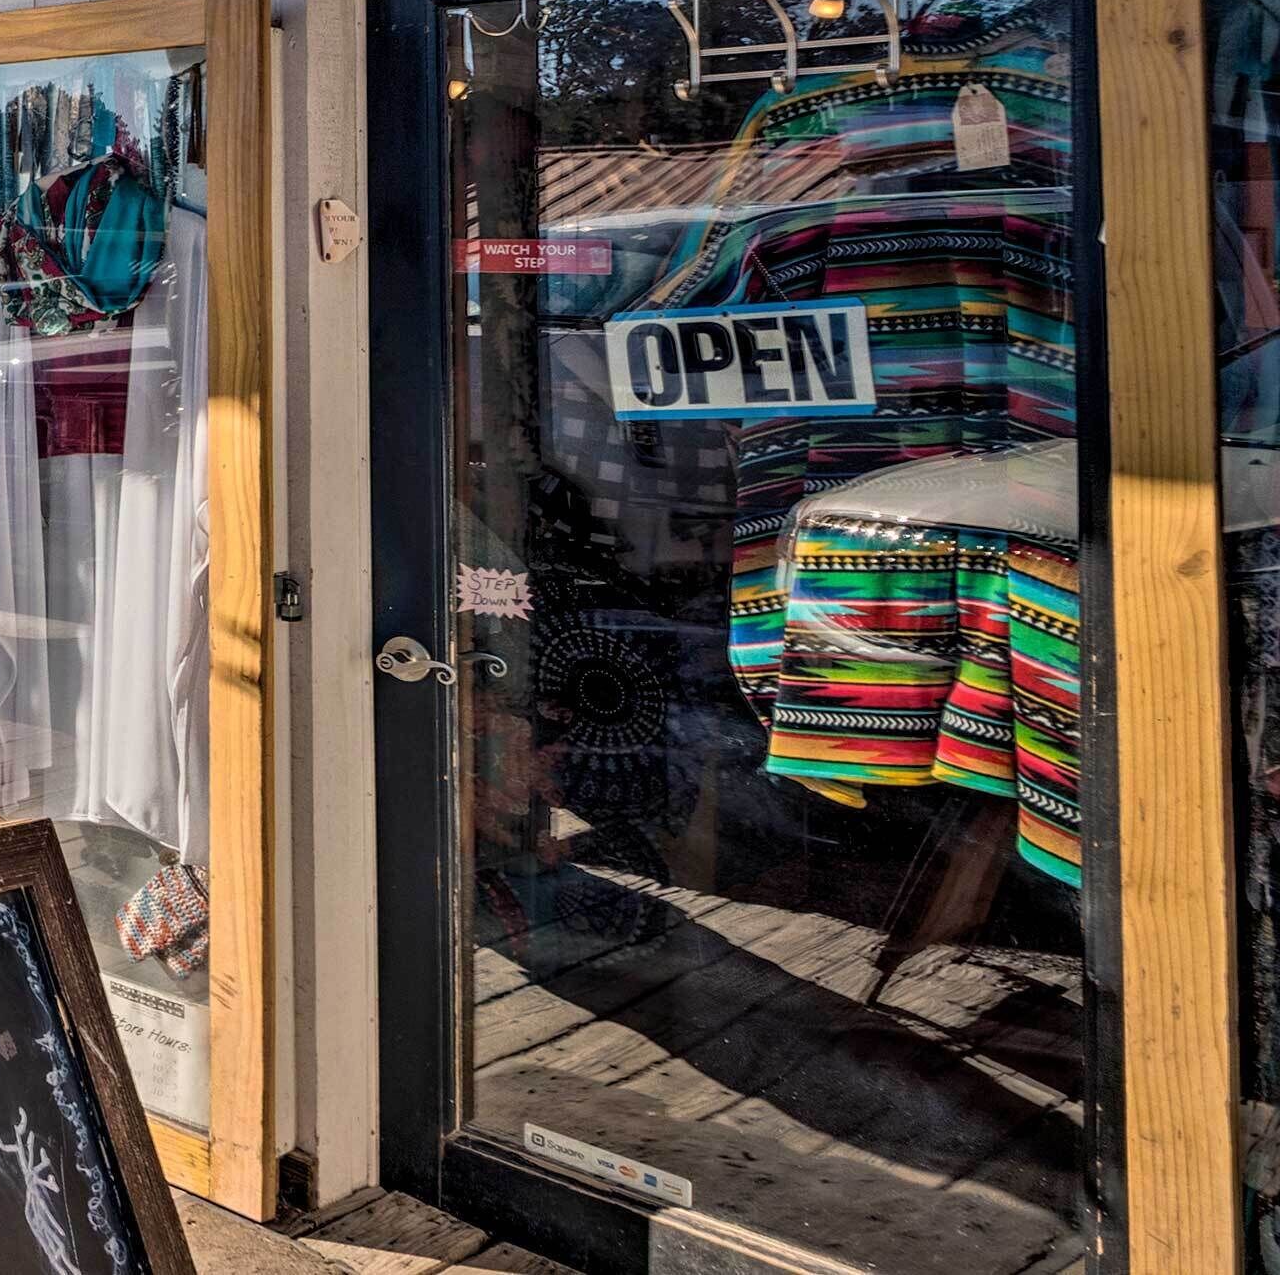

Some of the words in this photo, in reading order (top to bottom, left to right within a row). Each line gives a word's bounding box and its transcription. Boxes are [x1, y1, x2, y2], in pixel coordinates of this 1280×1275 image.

[483, 244, 530, 256] WATCH
[537, 244, 577, 256] YOUR
[514, 257, 547, 269] STEP
[625, 311, 858, 408] OPEN
[467, 572, 517, 592] STEP
[148, 1028, 192, 1054] Hours:
[546, 1139, 585, 1161] Square
